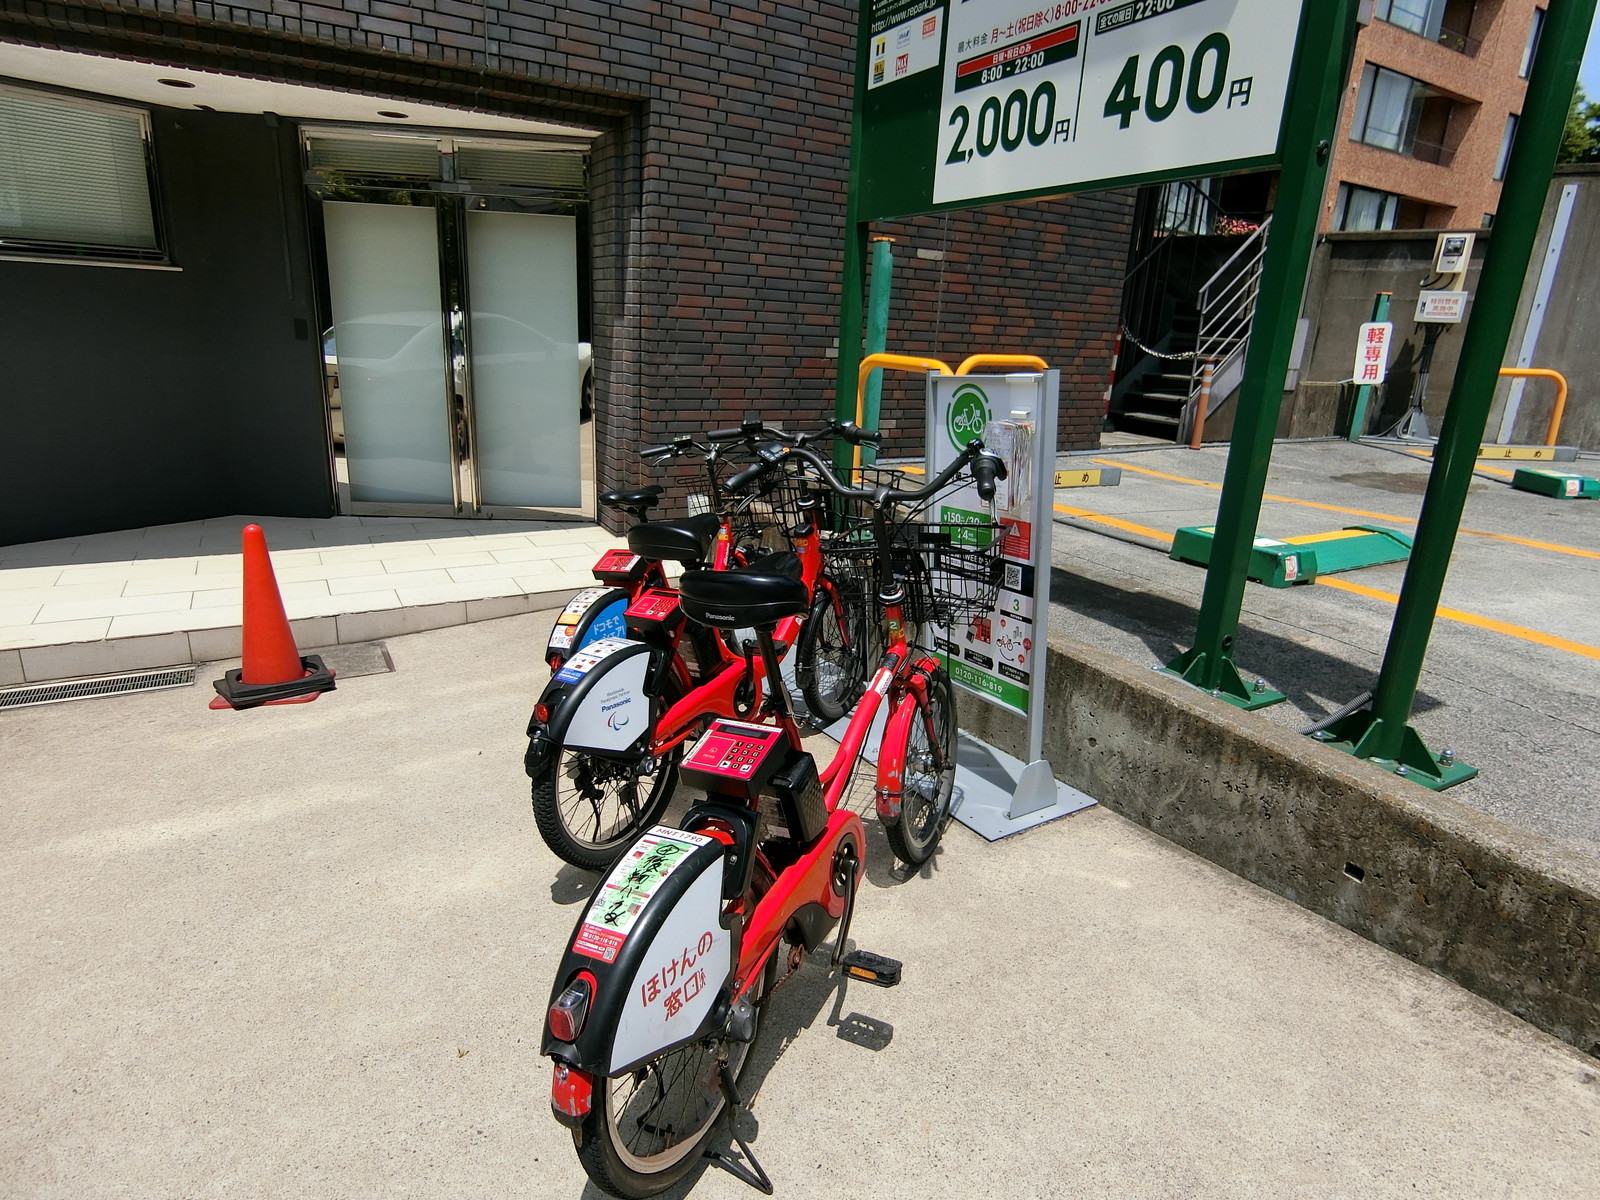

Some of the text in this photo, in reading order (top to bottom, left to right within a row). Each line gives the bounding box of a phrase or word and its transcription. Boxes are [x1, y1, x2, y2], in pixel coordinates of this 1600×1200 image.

[958, 32, 988, 53] 最大料金
[981, 64, 1003, 84] 8:00
[1014, 51, 1045, 74] 22:00
[1362, 327, 1385, 380] 軽専用
[1013, 598, 1020, 612] 3
[593, 615, 620, 636] ドコモで
[705, 612, 735, 622] Panasonic
[889, 621, 898, 630] 2
[954, 667, 1003, 694] 0120-116-819
[601, 697, 632, 712] Panasonic
[641, 931, 713, 1008] ほけんの
[663, 971, 701, 1022] 窓口
